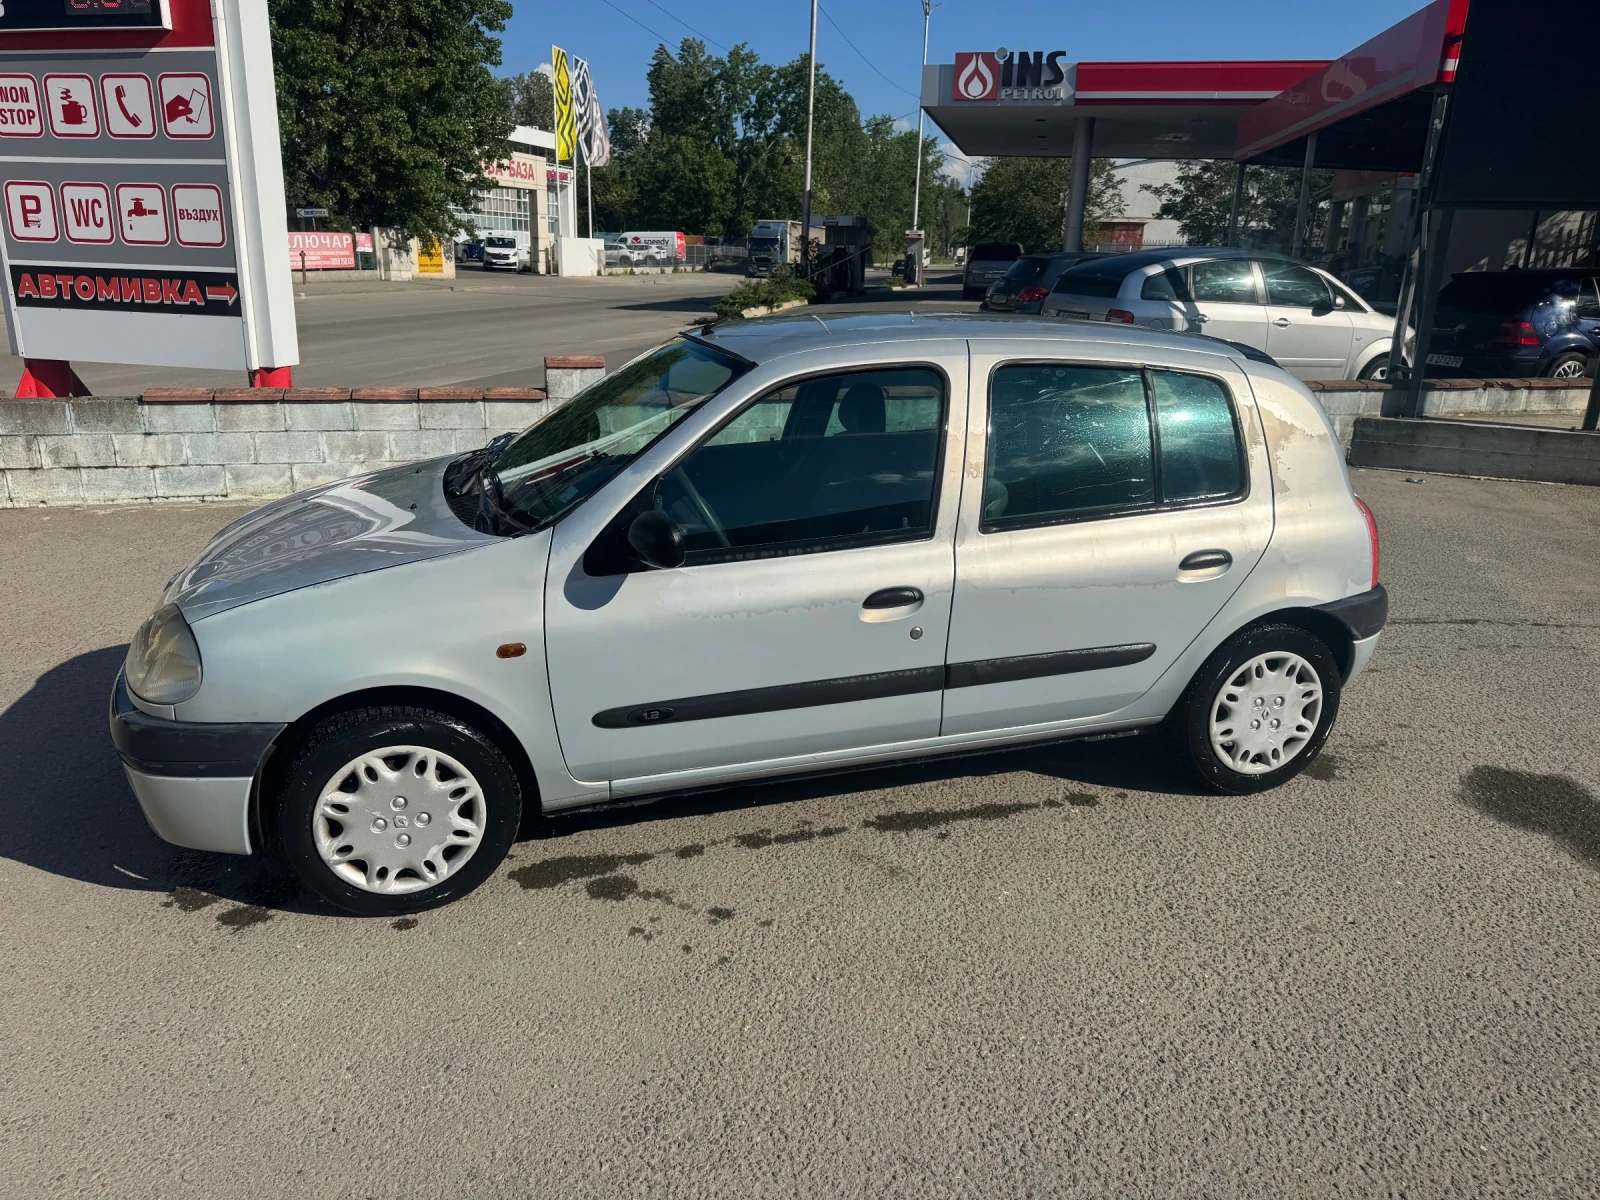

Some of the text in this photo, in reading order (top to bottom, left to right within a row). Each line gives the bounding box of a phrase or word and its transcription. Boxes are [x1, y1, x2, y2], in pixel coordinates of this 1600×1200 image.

[0, 86, 30, 103] NON
[1001, 88, 1063, 100] PETROL
[0, 108, 36, 126] STOP
[508, 160, 535, 180] БАЗА
[70, 198, 104, 228] WC
[179, 208, 219, 222] ВЪЗДУХ
[643, 238, 669, 246] speedy
[18, 273, 205, 305] АВТОМИВКА
[642, 710, 660, 720] 1.2
